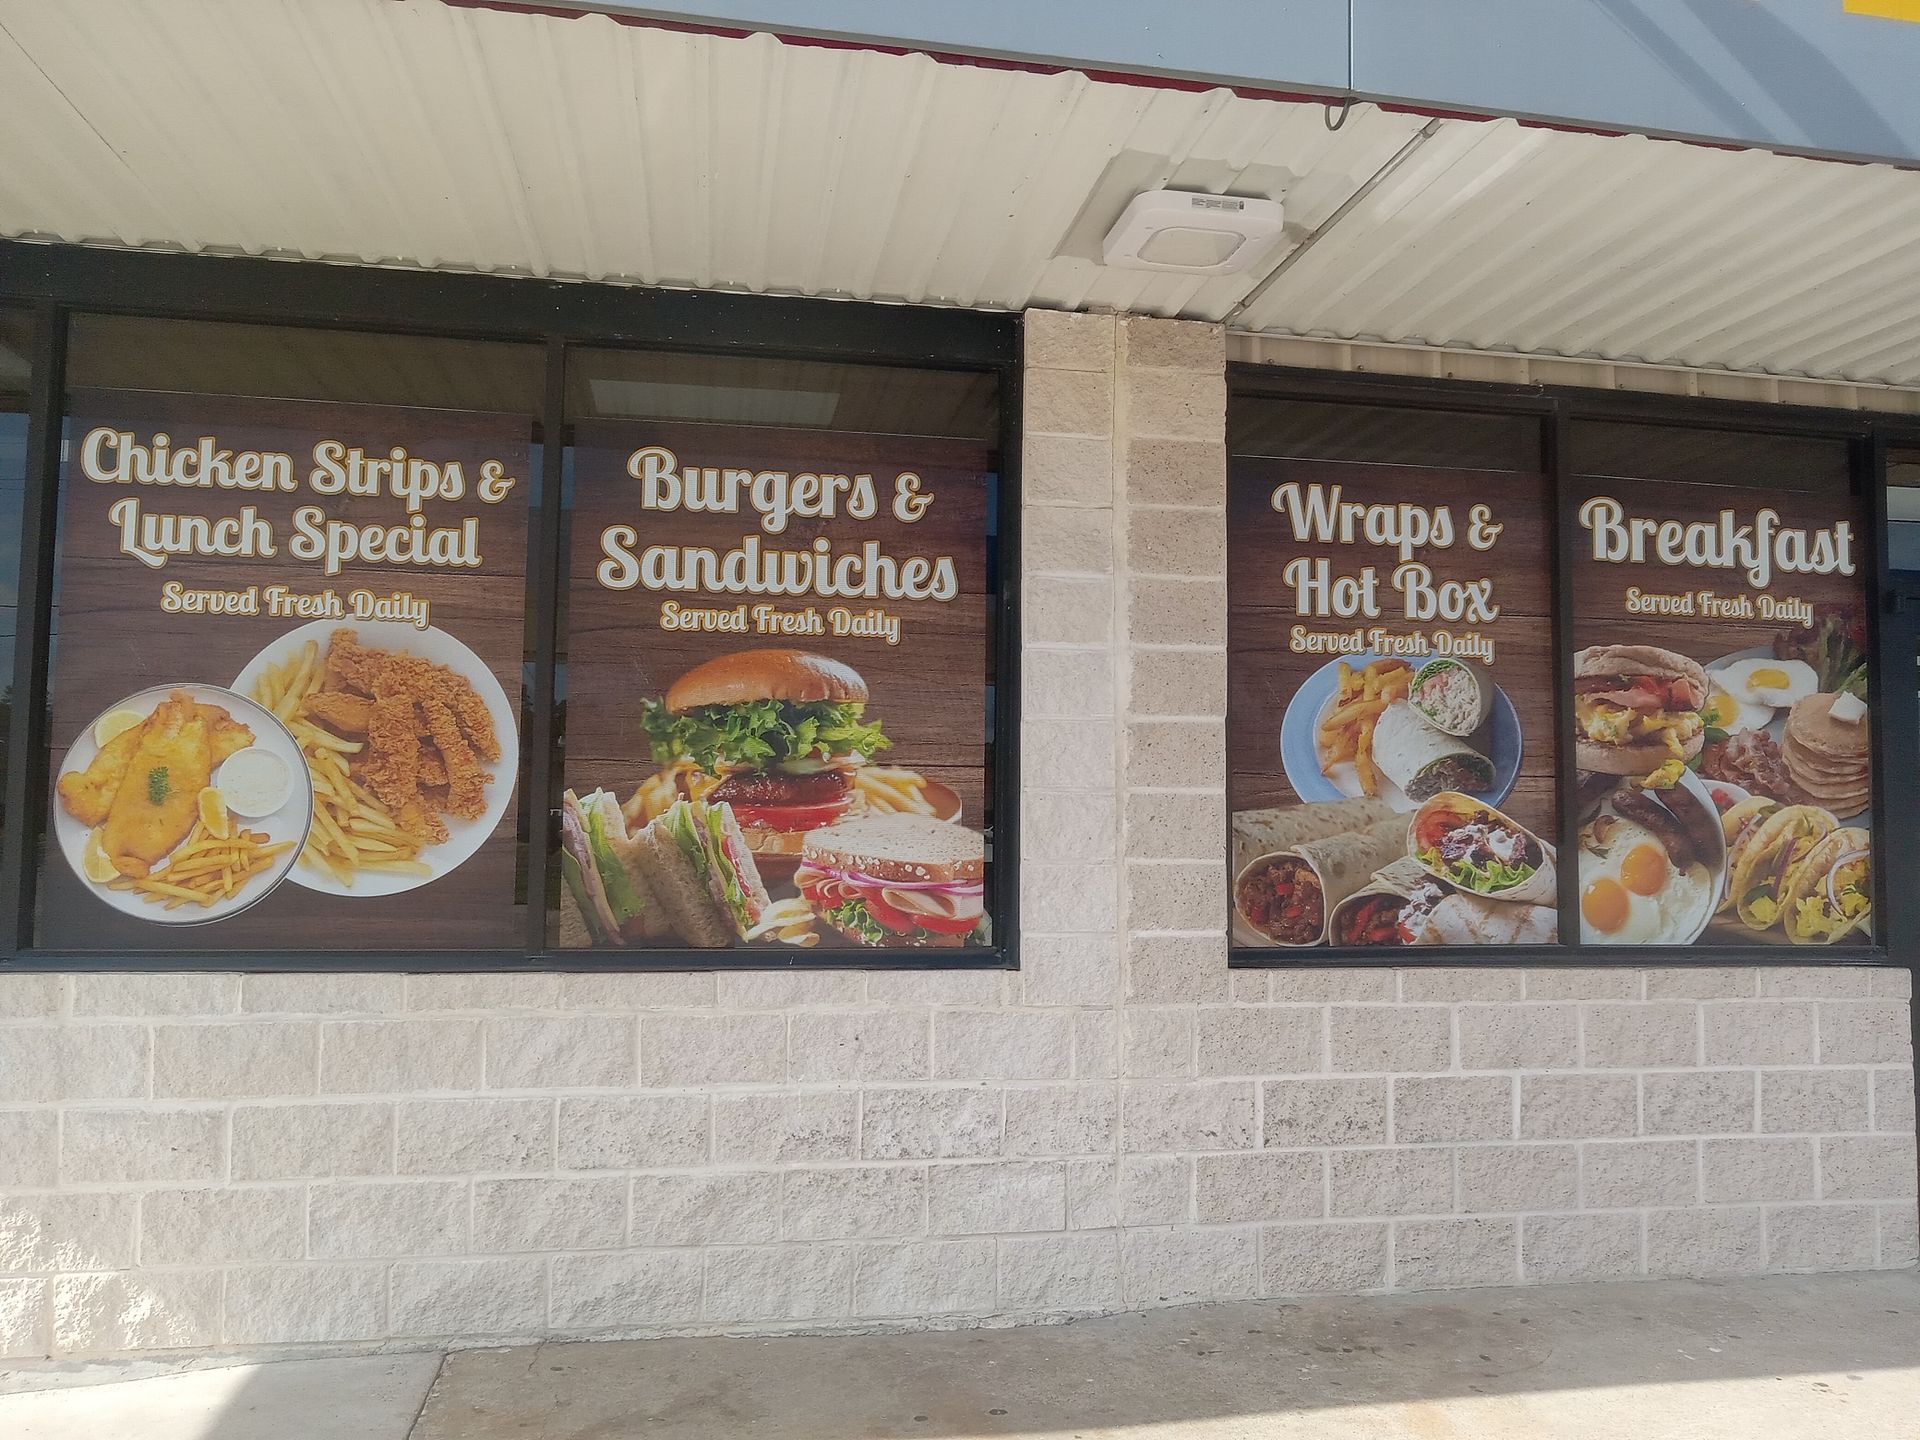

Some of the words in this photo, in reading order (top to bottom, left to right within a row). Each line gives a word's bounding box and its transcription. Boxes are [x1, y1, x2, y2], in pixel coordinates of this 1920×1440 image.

[81, 426, 298, 491] Chicken
[309, 440, 465, 513] Strips
[477, 460, 515, 503] &
[627, 445, 879, 534] Burgers
[893, 471, 935, 523] &
[108, 497, 277, 569] Lunch
[290, 505, 483, 575] Special
[1271, 482, 1455, 563] Wraps
[1467, 504, 1504, 551] &
[1578, 496, 1856, 589] Breakfast
[597, 524, 959, 601] Sandwiches
[1282, 557, 1381, 619] Hot
[1391, 562, 1500, 623] Box
[160, 580, 259, 617] Served
[263, 585, 344, 619] Fresh
[348, 588, 431, 630] Daily
[660, 600, 749, 632] Served
[751, 602, 824, 636] Fresh
[828, 607, 901, 646] Daily
[1625, 586, 1696, 616] Served
[1697, 590, 1755, 620] Fresh
[1756, 593, 1814, 629] Daily
[1290, 624, 1365, 655] Served
[1367, 627, 1430, 657] Fresh
[1432, 631, 1495, 666] Daily
